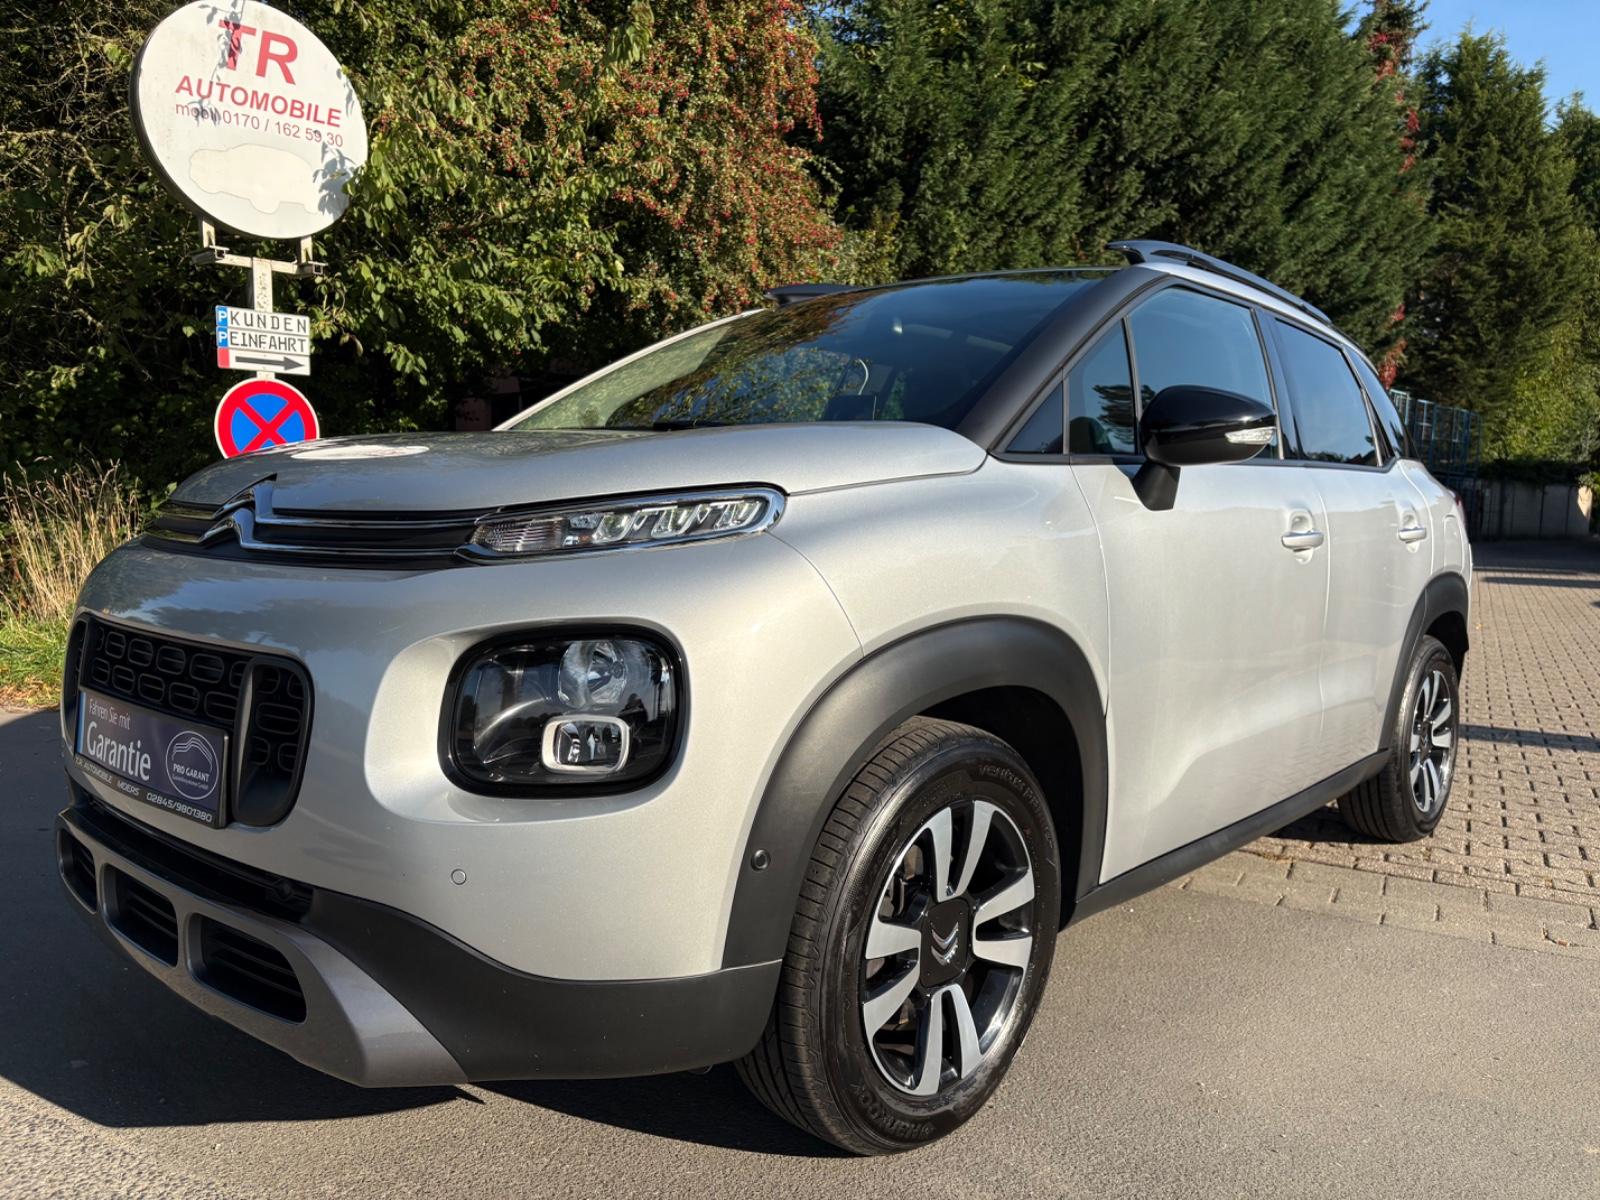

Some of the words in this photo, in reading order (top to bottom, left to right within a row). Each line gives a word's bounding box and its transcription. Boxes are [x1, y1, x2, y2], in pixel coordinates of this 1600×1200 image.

[219, 19, 298, 85] TR
[175, 75, 342, 126] AUTOMOBILE
[222, 110, 260, 130] 0170
[264, 118, 270, 132] /
[275, 121, 301, 139] 162
[305, 127, 322, 143] 59
[326, 132, 343, 148] 30
[230, 310, 307, 334] KUNDEN
[230, 331, 307, 352] EINFAHRT
[89, 698, 108, 720] Fahren
[108, 706, 118, 725] Sie
[119, 712, 131, 730] mit
[86, 720, 151, 782] Garantie
[172, 763, 185, 775] PRO
[185, 767, 210, 782] GARANT
[117, 780, 140, 796] MOERS
[146, 792, 213, 823] 02845/9801380
